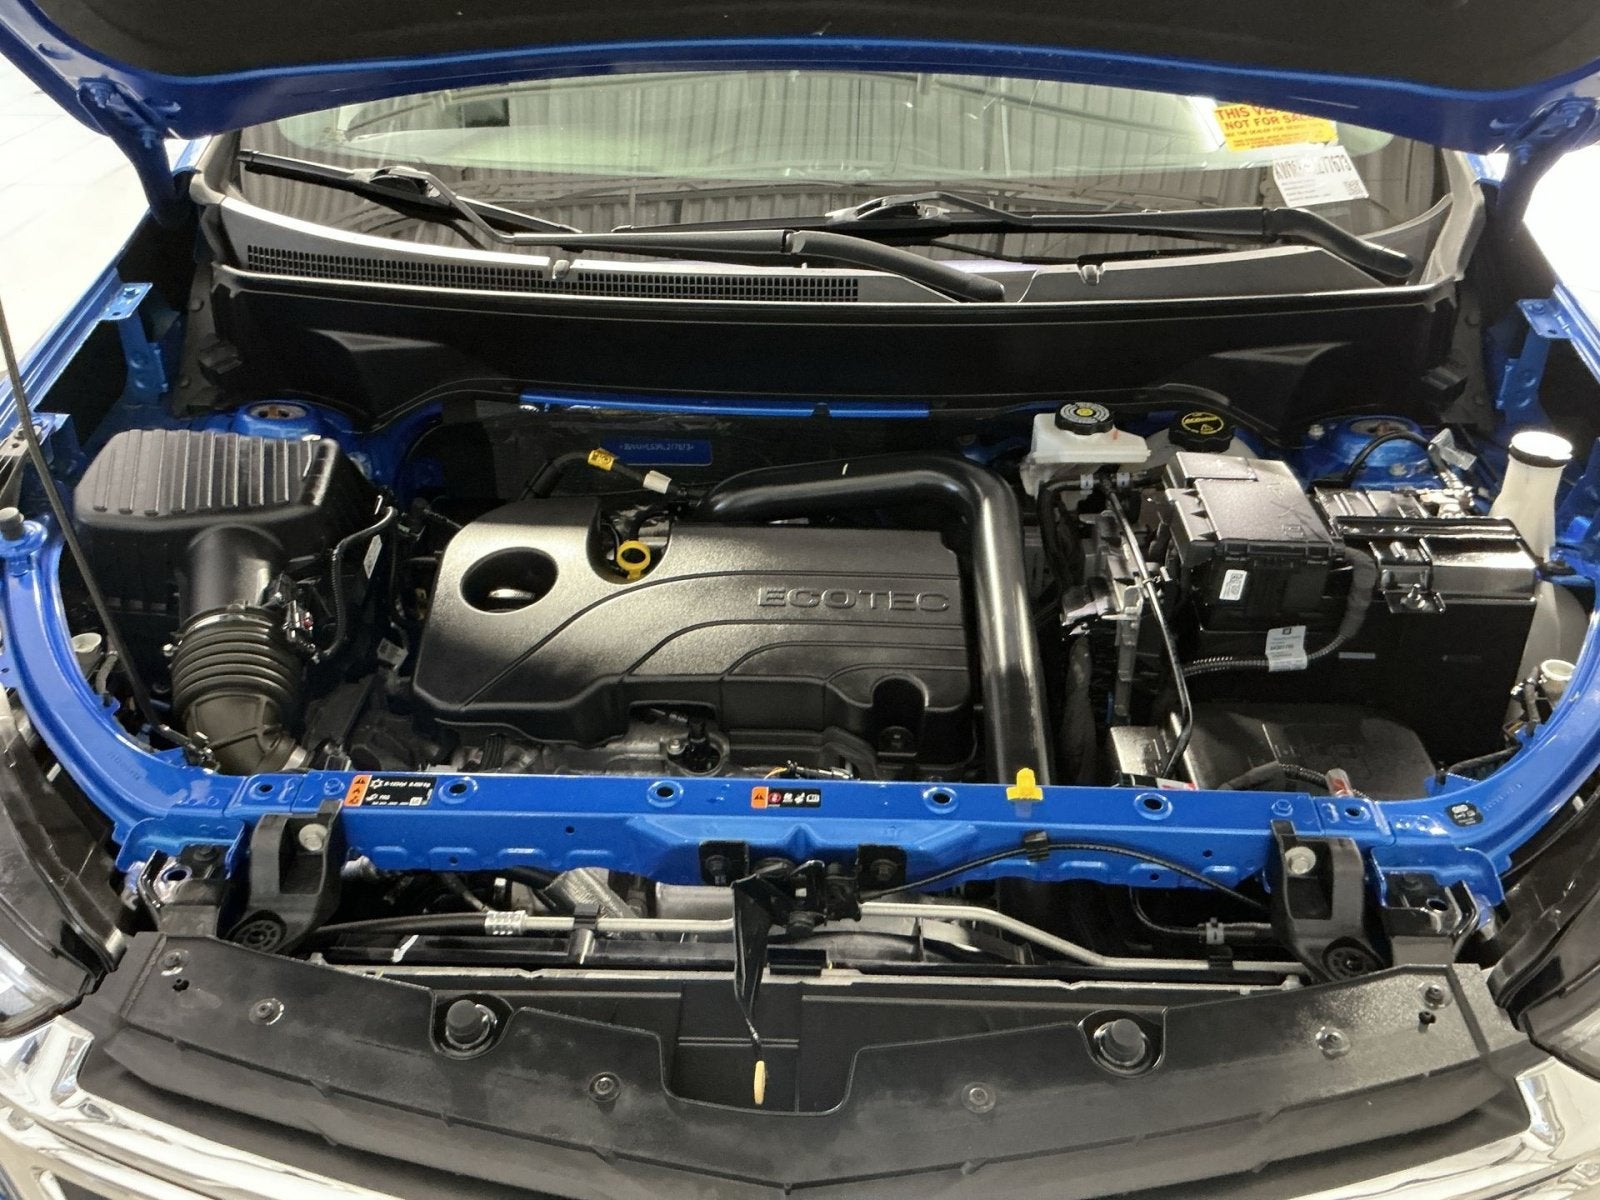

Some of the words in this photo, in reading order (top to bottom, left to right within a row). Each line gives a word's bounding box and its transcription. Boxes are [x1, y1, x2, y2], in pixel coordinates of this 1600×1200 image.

[1215, 106, 1250, 121] THIS
[1225, 119, 1250, 130] NOT
[1254, 116, 1280, 126] FOR
[757, 586, 950, 612] ECOTEC
